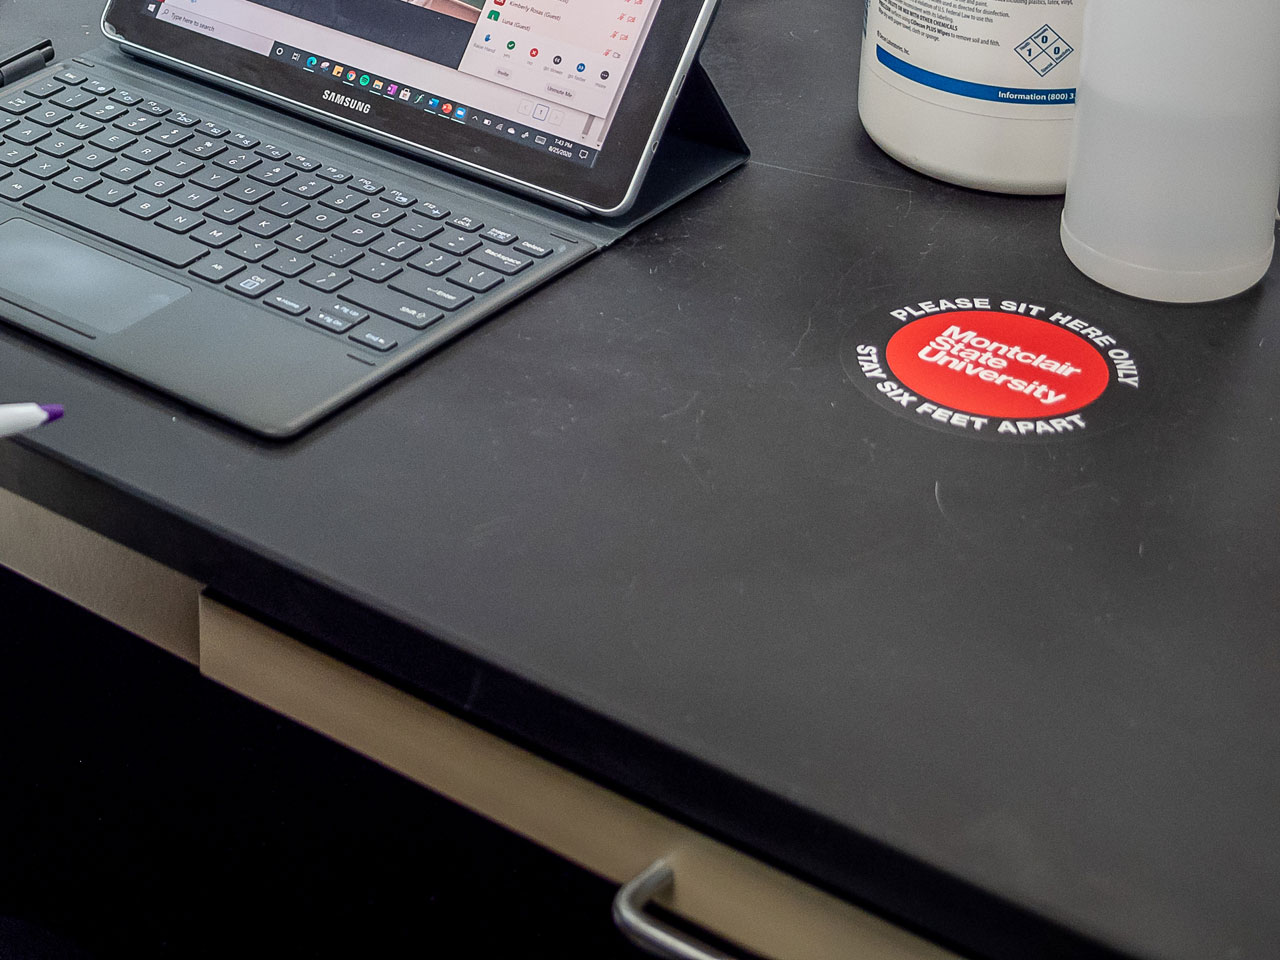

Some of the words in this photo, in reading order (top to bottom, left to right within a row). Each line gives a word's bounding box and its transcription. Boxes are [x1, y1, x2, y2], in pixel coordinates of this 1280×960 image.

[171, 12, 182, 21] Type
[199, 22, 215, 32] search
[1041, 35, 1048, 44] 0
[1053, 46, 1060, 55] 0
[1026, 48, 1032, 57] 1
[322, 90, 371, 114] SAMSUNG
[998, 91, 1046, 101] Information
[1047, 92, 1068, 101] (800)
[890, 297, 991, 321] PLEASE
[1000, 300, 1045, 316] SIT
[1049, 311, 1117, 348] HERE
[1107, 348, 1139, 388] ONLY
[929, 336, 1007, 369] State
[941, 325, 1082, 377] Montclair
[917, 345, 1066, 405] University
[856, 344, 888, 379] STAY
[876, 380, 917, 407] SIX
[916, 402, 988, 430] FEET
[997, 413, 1086, 435] APART
